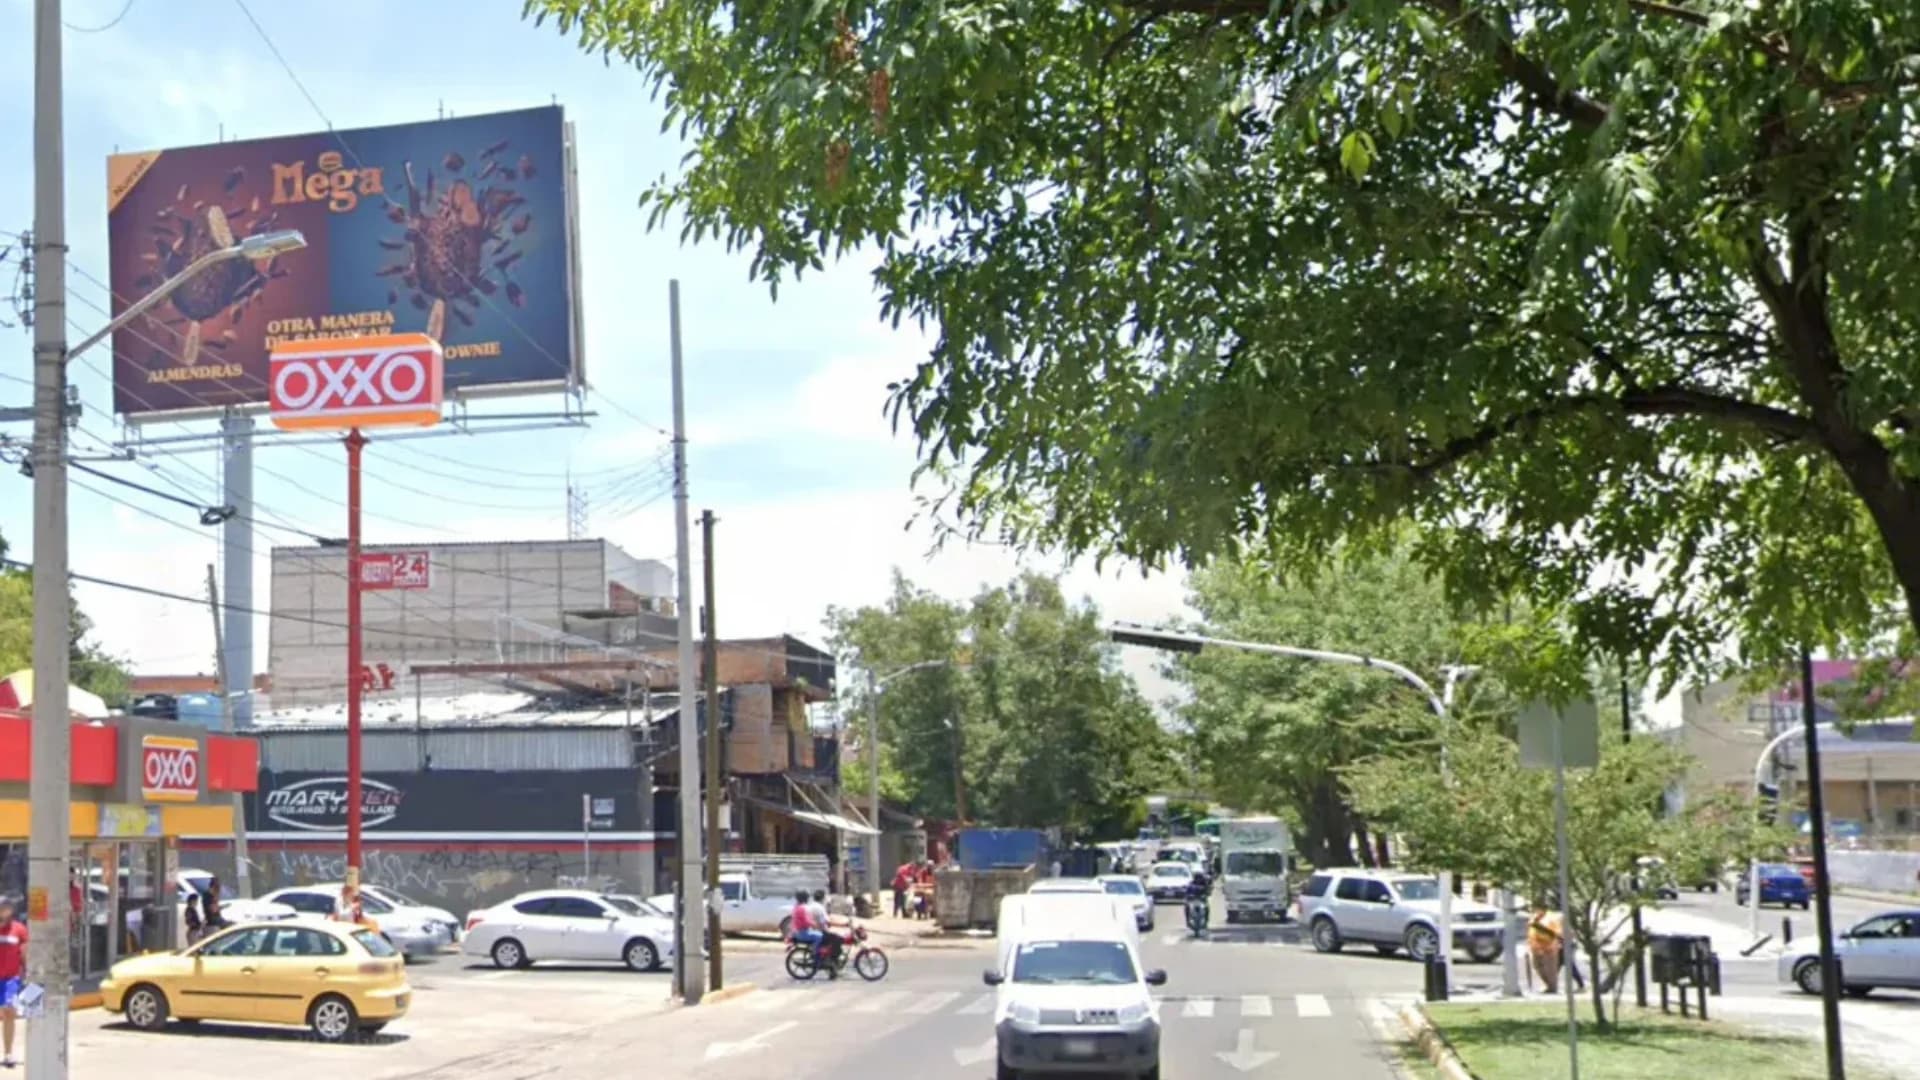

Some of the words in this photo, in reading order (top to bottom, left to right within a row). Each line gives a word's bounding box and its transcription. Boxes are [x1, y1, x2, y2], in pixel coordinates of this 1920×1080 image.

[271, 161, 384, 213] Mega
[266, 318, 316, 334] OTRA
[320, 311, 395, 330] MANERA
[146, 363, 243, 384] ALMENDRAS
[275, 351, 426, 411] OXXO
[394, 554, 425, 577] 24
[145, 748, 197, 790] OXXO
